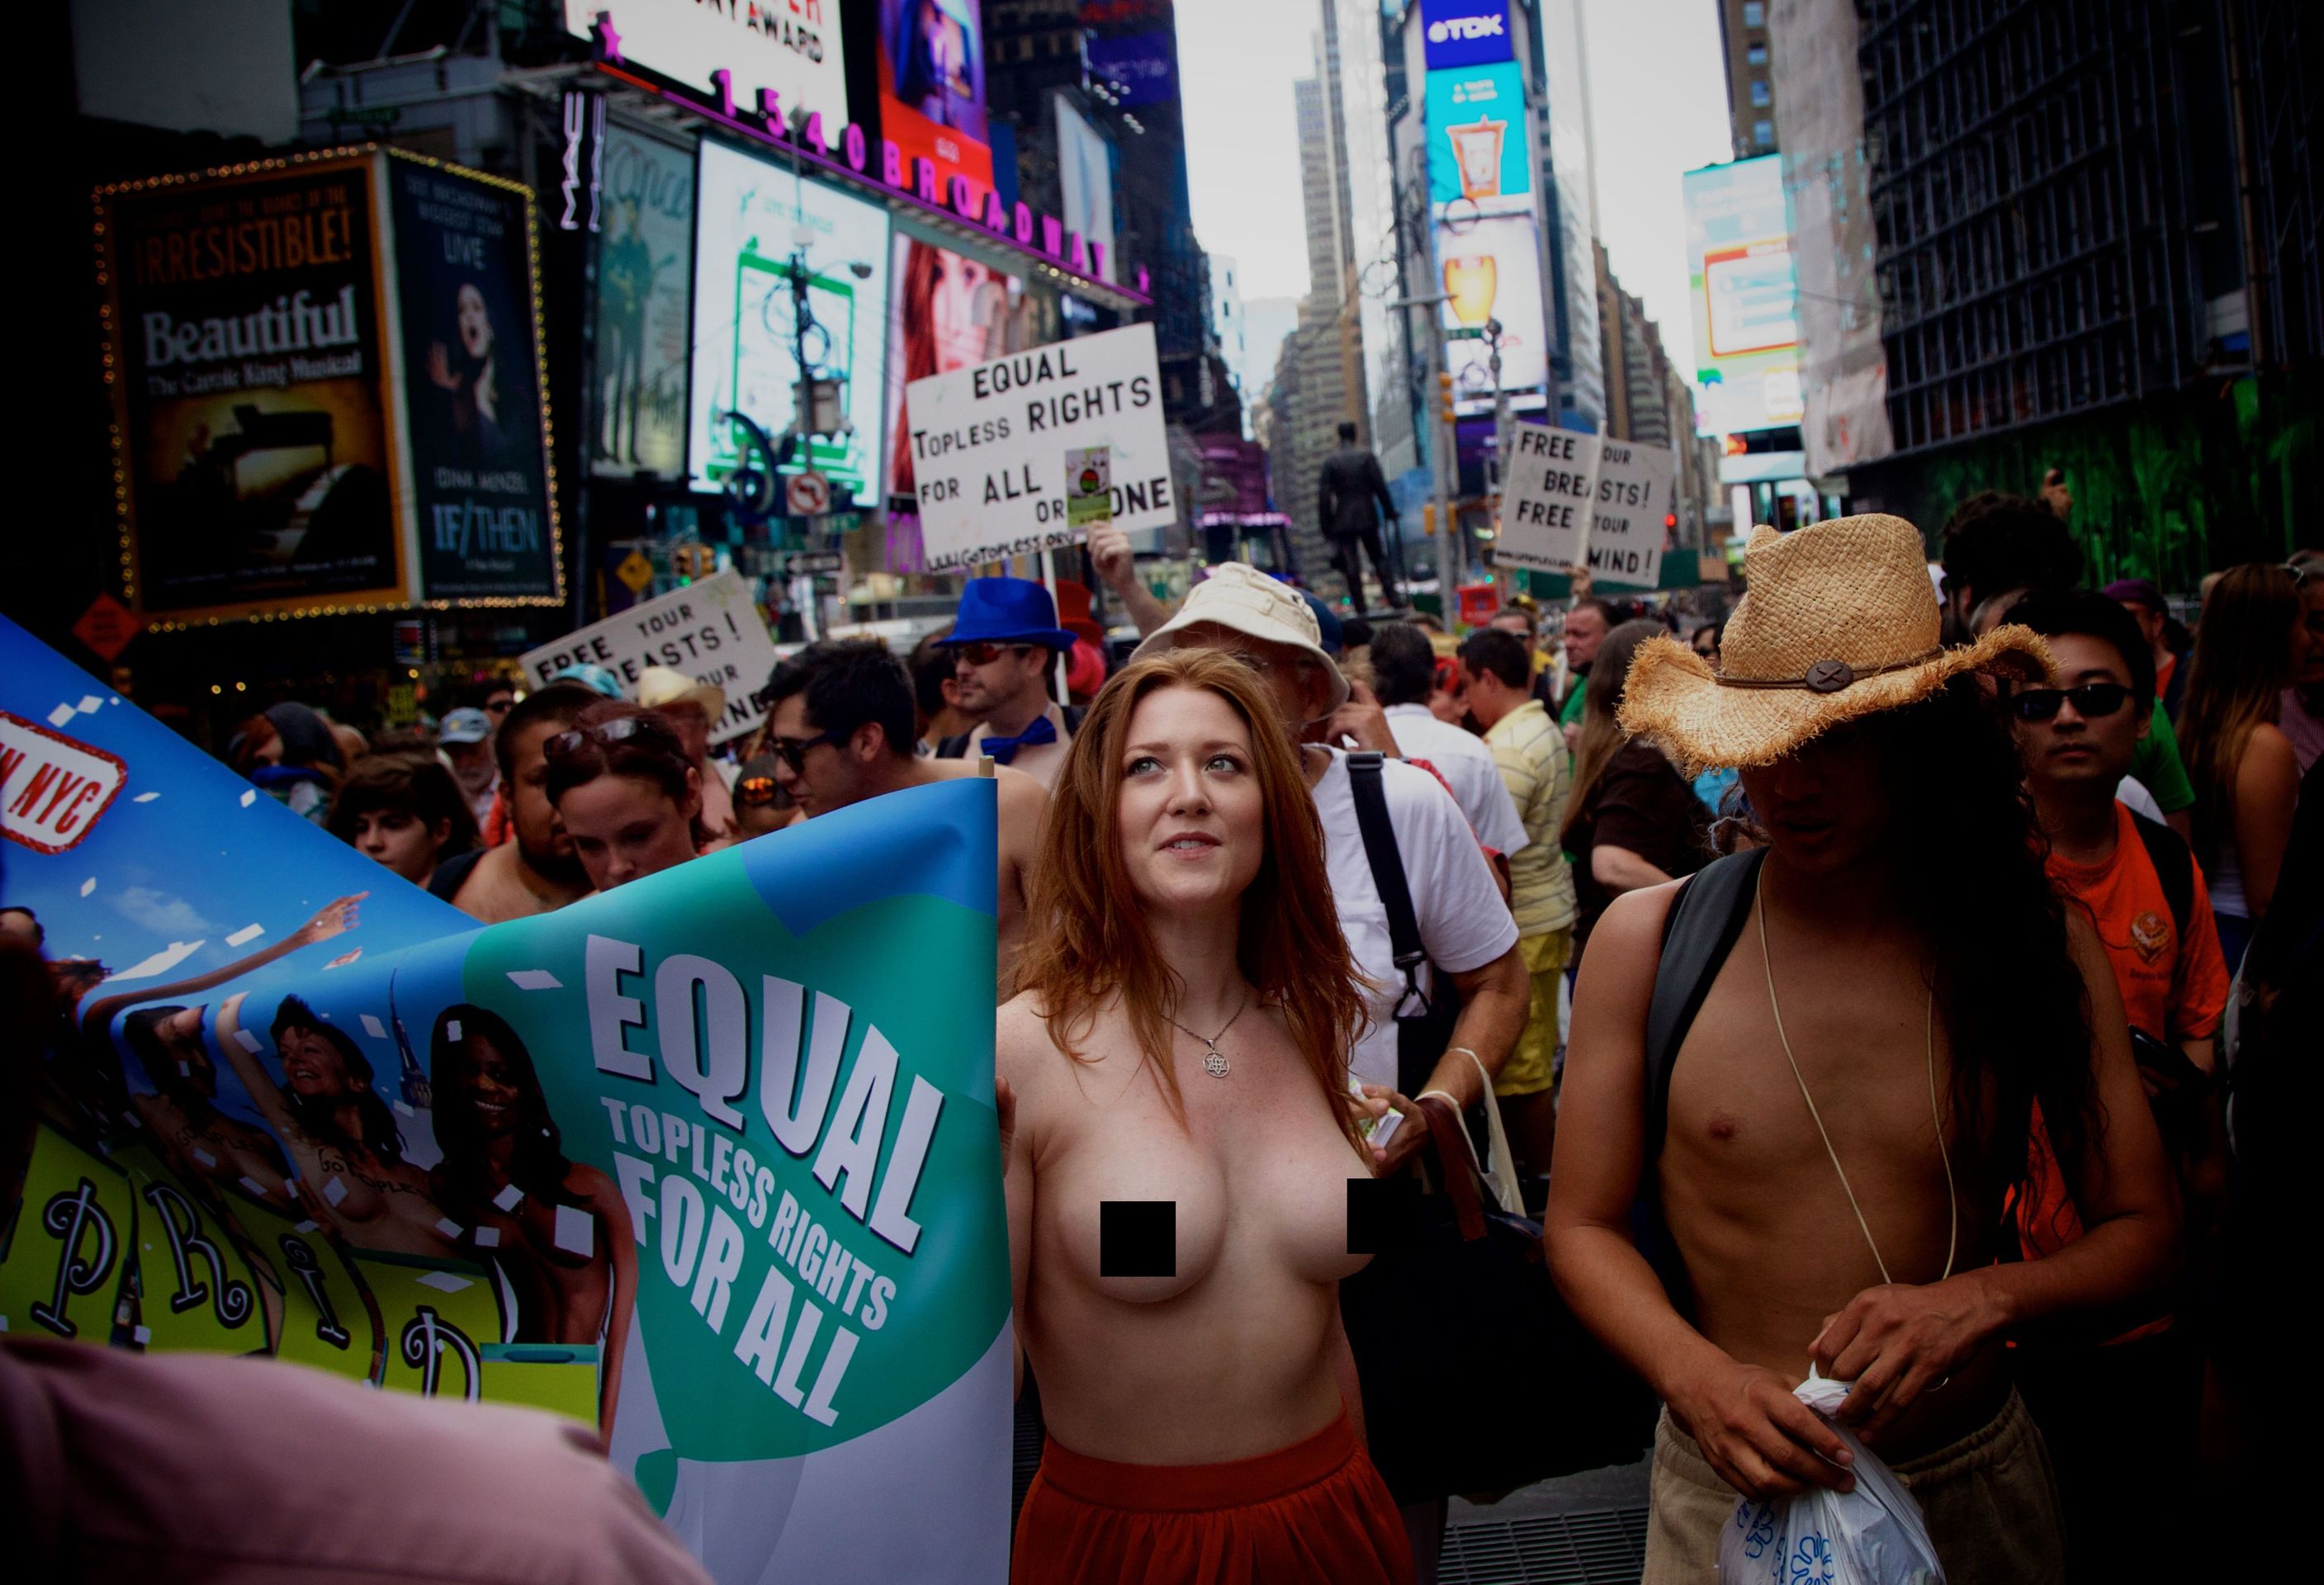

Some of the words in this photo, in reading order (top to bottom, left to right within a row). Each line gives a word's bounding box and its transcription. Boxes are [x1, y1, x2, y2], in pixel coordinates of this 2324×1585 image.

[1446, 14, 1503, 40] TDK
[715, 68, 866, 172] 1540
[883, 140, 1104, 279] BROADWAY
[134, 207, 357, 286] IRRESISTIBLE!
[443, 229, 487, 271] LIVE
[141, 282, 362, 371] Beautiful
[291, 348, 363, 381] Musical
[973, 348, 1078, 400] EQUAL
[1027, 376, 1152, 433] RIGHTS
[1520, 430, 1576, 461] FREE
[1602, 447, 1632, 466] OUR
[920, 477, 960, 506] FOR
[982, 465, 1042, 506] ALL
[1543, 469, 1651, 509] BRESTS!
[431, 496, 540, 559] IF/THEN
[1035, 498, 1064, 523] OR
[1517, 498, 1574, 529] FREE
[1594, 514, 1631, 535] YOUR
[1588, 545, 1653, 577] MIND!
[636, 603, 695, 637] YOUR
[7, 762, 102, 835] NYC
[585, 933, 946, 1254] EQUAL
[600, 1095, 776, 1229] TOPLESS
[767, 1189, 897, 1331] RIGHTS
[613, 1150, 745, 1336] FOR
[733, 1265, 861, 1427] ALL
